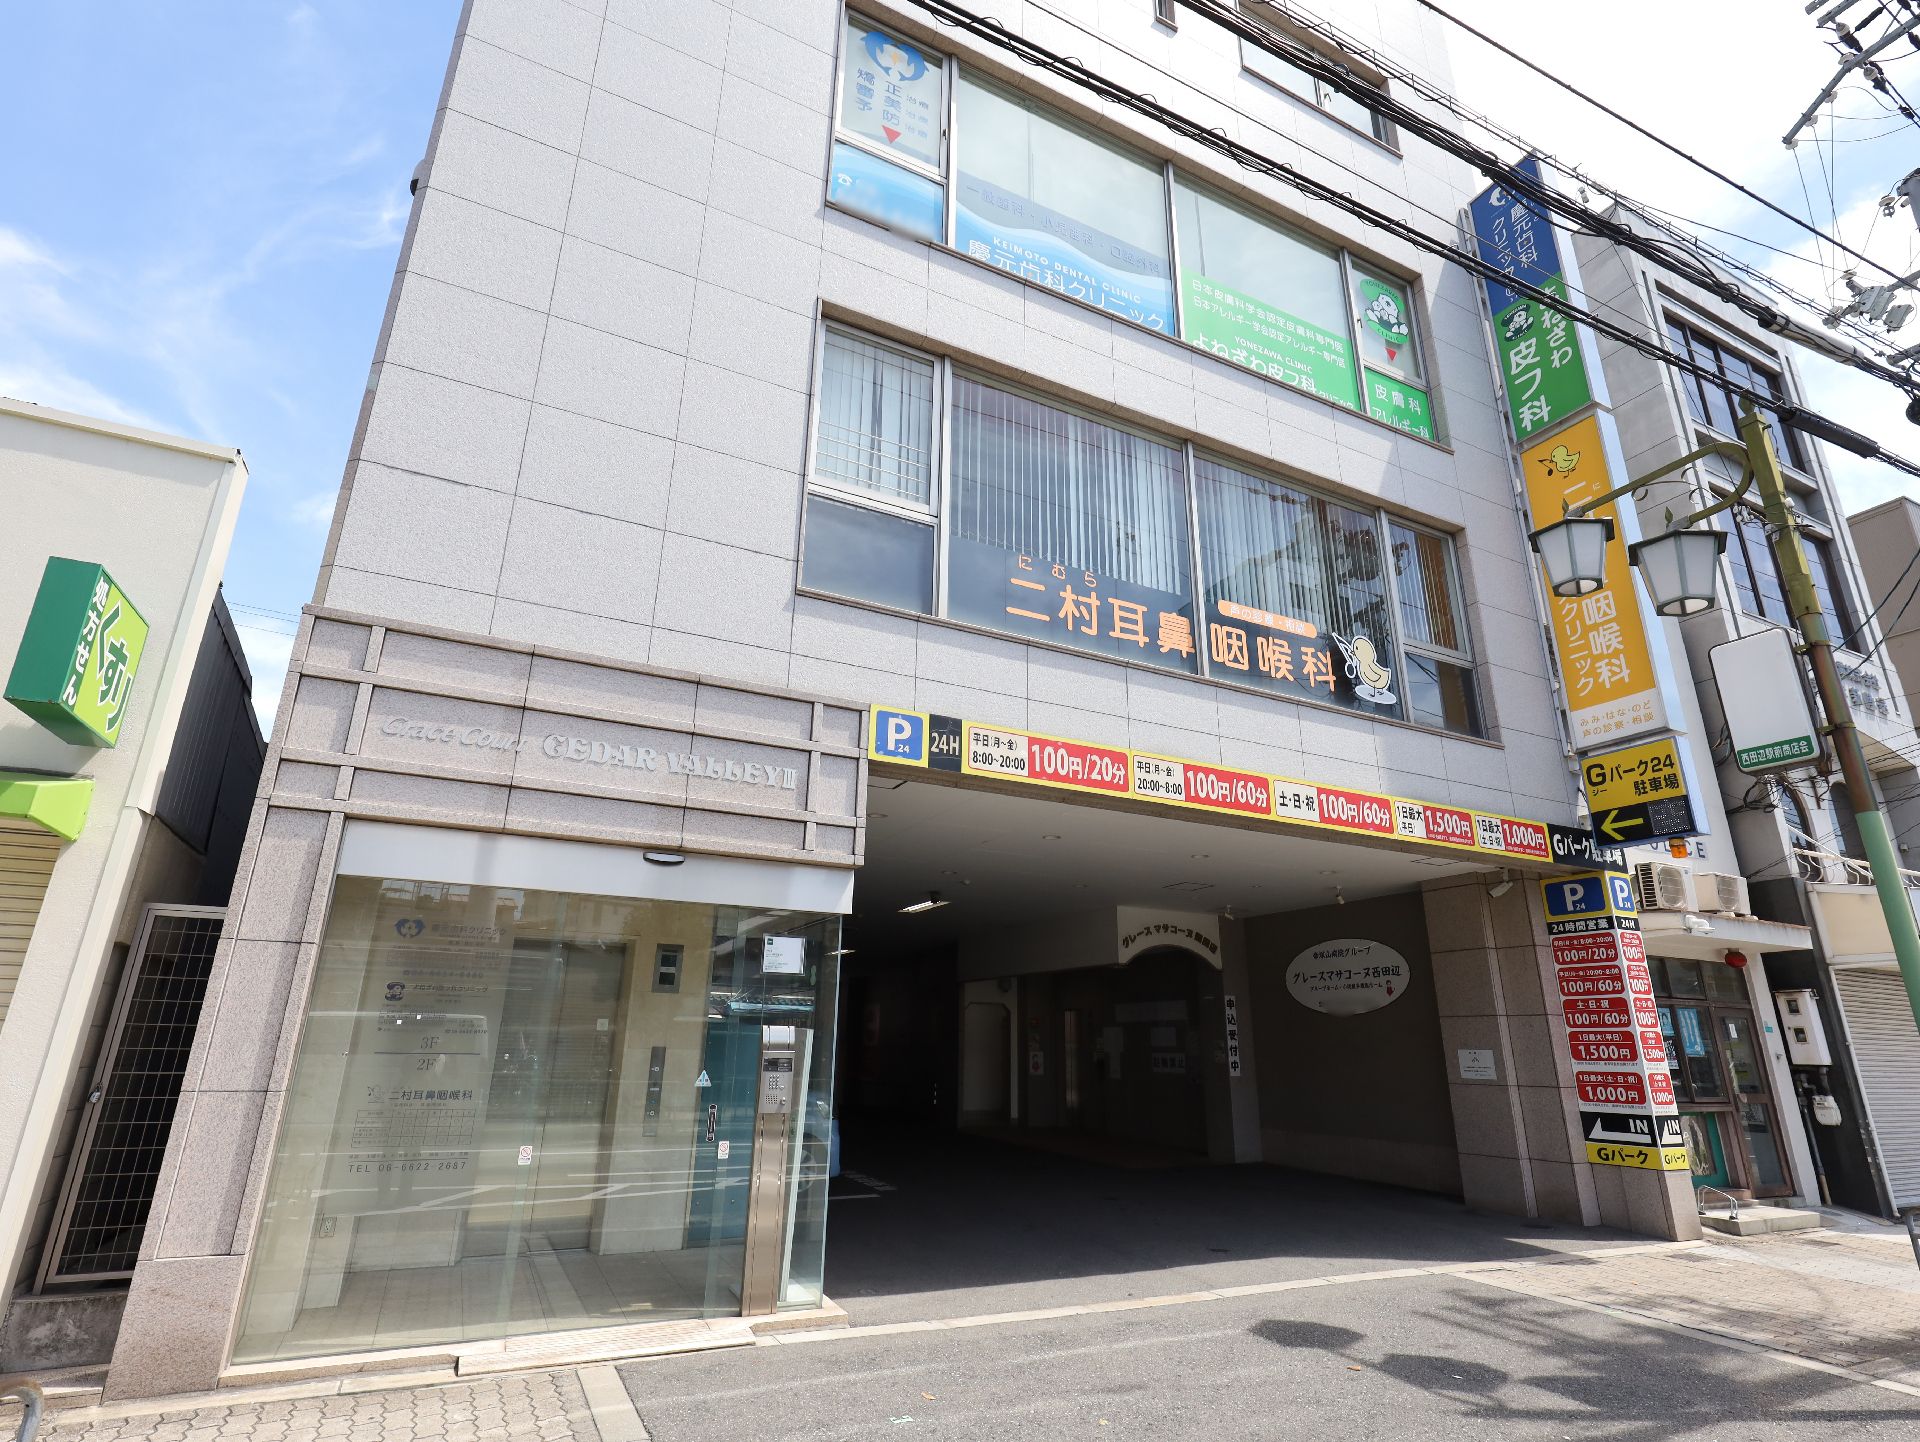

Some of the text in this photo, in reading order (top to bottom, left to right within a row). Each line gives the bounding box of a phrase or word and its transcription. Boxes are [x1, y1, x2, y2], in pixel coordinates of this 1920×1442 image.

[993, 236, 1142, 304] KEIMOTO DENTAL CLINIC
[1235, 335, 1313, 375] YONEZAWA CLINIC
[1509, 337, 1551, 432] 皮フ科
[1374, 383, 1421, 416] 皮膚科
[1018, 554, 1097, 588] にむら
[62, 576, 107, 707] 処方せん
[97, 600, 133, 733] くすり
[930, 731, 960, 757] 24H
[1031, 744, 1126, 785] 100円/20分
[1585, 753, 1675, 788] Gパーク24
[1186, 770, 1268, 808] 100円/60分
[1633, 772, 1680, 797] 駐車場
[1319, 793, 1391, 828] 100円/60分
[1396, 805, 1424, 822] 1日最大
[1426, 810, 1472, 838] 1,500円
[1504, 823, 1546, 850] 1,000円
[1552, 918, 1610, 934] 24時間営業
[1621, 918, 1636, 929] 24H
[1556, 947, 1616, 963] 100円/20分
[1561, 979, 1622, 993] 100円/60分
[1567, 1012, 1629, 1026] 100円/60分
[420, 1036, 440, 1051] 3F
[1226, 997, 1241, 1073] 申込受付中
[416, 1058, 434, 1072] 2F
[1577, 1045, 1631, 1060] 1,500円
[1585, 1085, 1640, 1102] 1,000円
[1628, 1118, 1650, 1134] IN
[1667, 1118, 1682, 1135] IN
[349, 1163, 371, 1173] TEL
[1596, 1147, 1649, 1166] Gパーク
[1664, 1153, 1687, 1166] Gパーク
